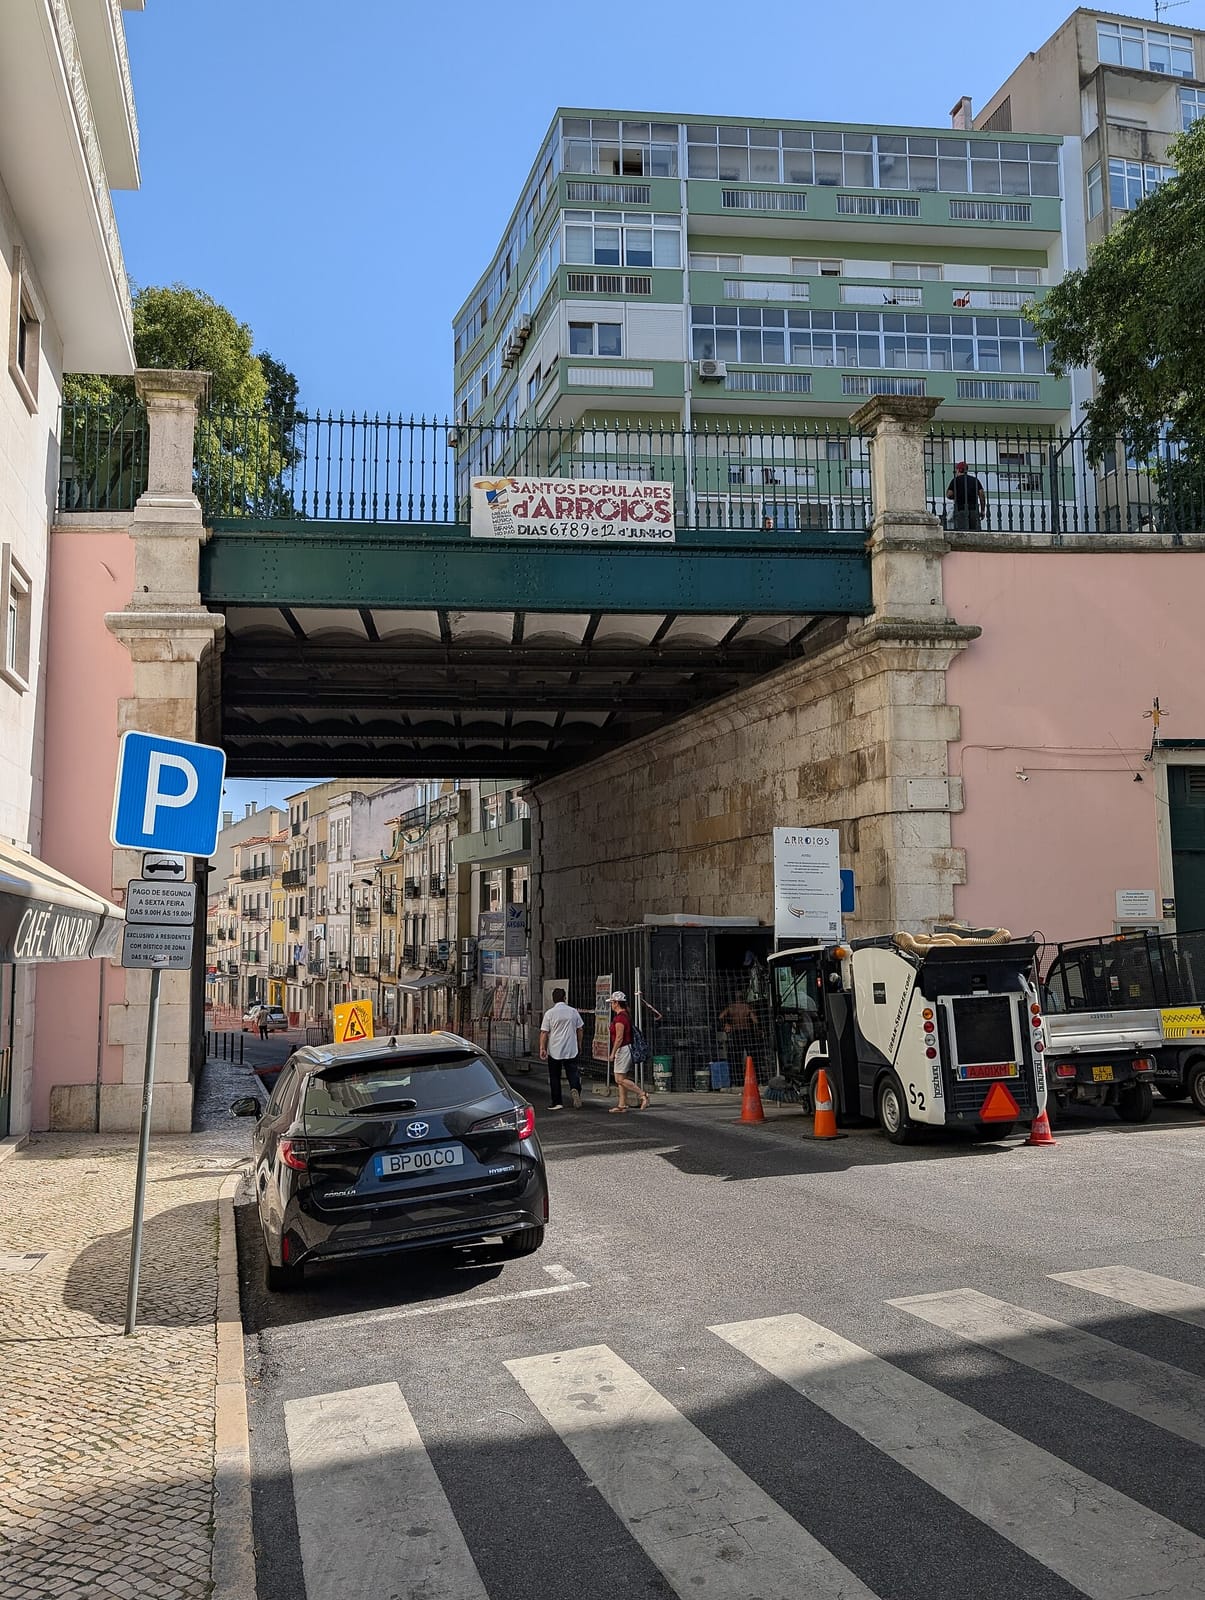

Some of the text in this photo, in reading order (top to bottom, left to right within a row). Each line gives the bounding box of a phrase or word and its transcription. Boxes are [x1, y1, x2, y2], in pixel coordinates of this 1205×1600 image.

[511, 482, 671, 499] SANTOS POPULARES
[517, 525, 547, 536] DIAS
[591, 527, 599, 536] e
[600, 524, 616, 538] 12
[142, 750, 199, 835] P
[784, 836, 830, 846] ARROIOS
[14, 903, 54, 958] CAFÉ
[909, 1083, 926, 1111] S2
[390, 1154, 411, 1172] BP
